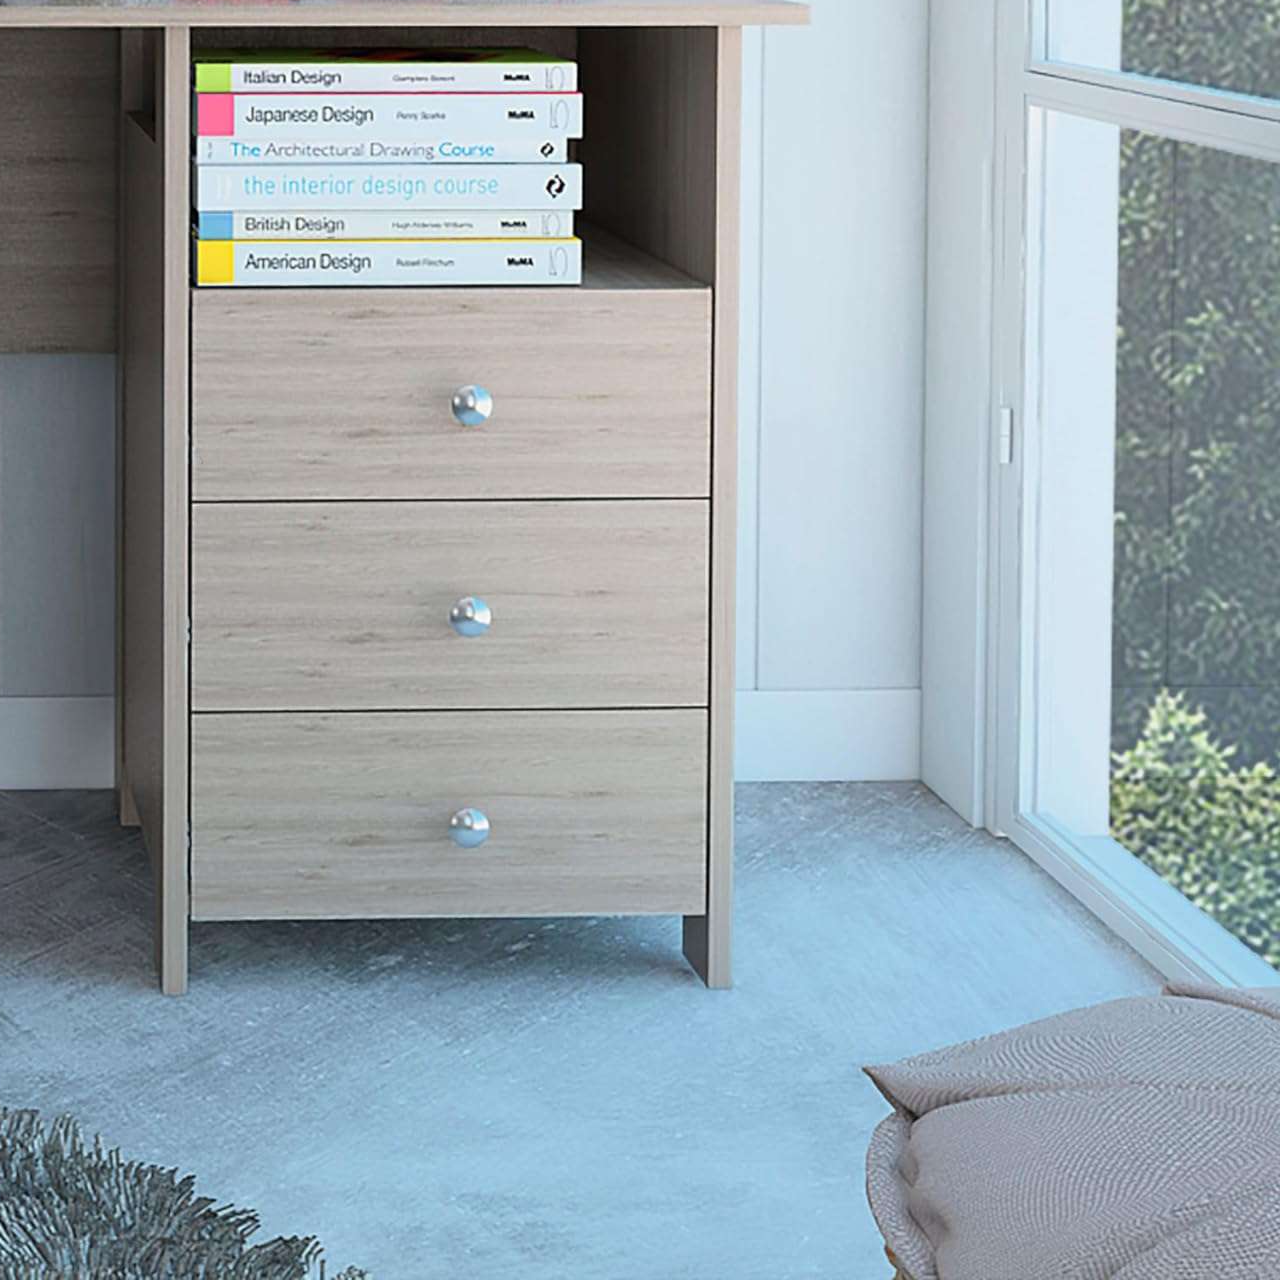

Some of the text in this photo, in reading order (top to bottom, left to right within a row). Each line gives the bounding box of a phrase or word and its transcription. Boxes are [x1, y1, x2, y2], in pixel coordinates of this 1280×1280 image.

[243, 71, 286, 84] Italian
[291, 70, 342, 86] Design
[245, 106, 318, 125] Japanese
[322, 106, 374, 126] Design
[231, 142, 495, 160] The Architectural Drawing Course
[244, 175, 499, 200] the interior design course
[245, 217, 291, 232] British
[295, 217, 345, 234] Design
[245, 253, 317, 270] American
[320, 253, 372, 273] Design
